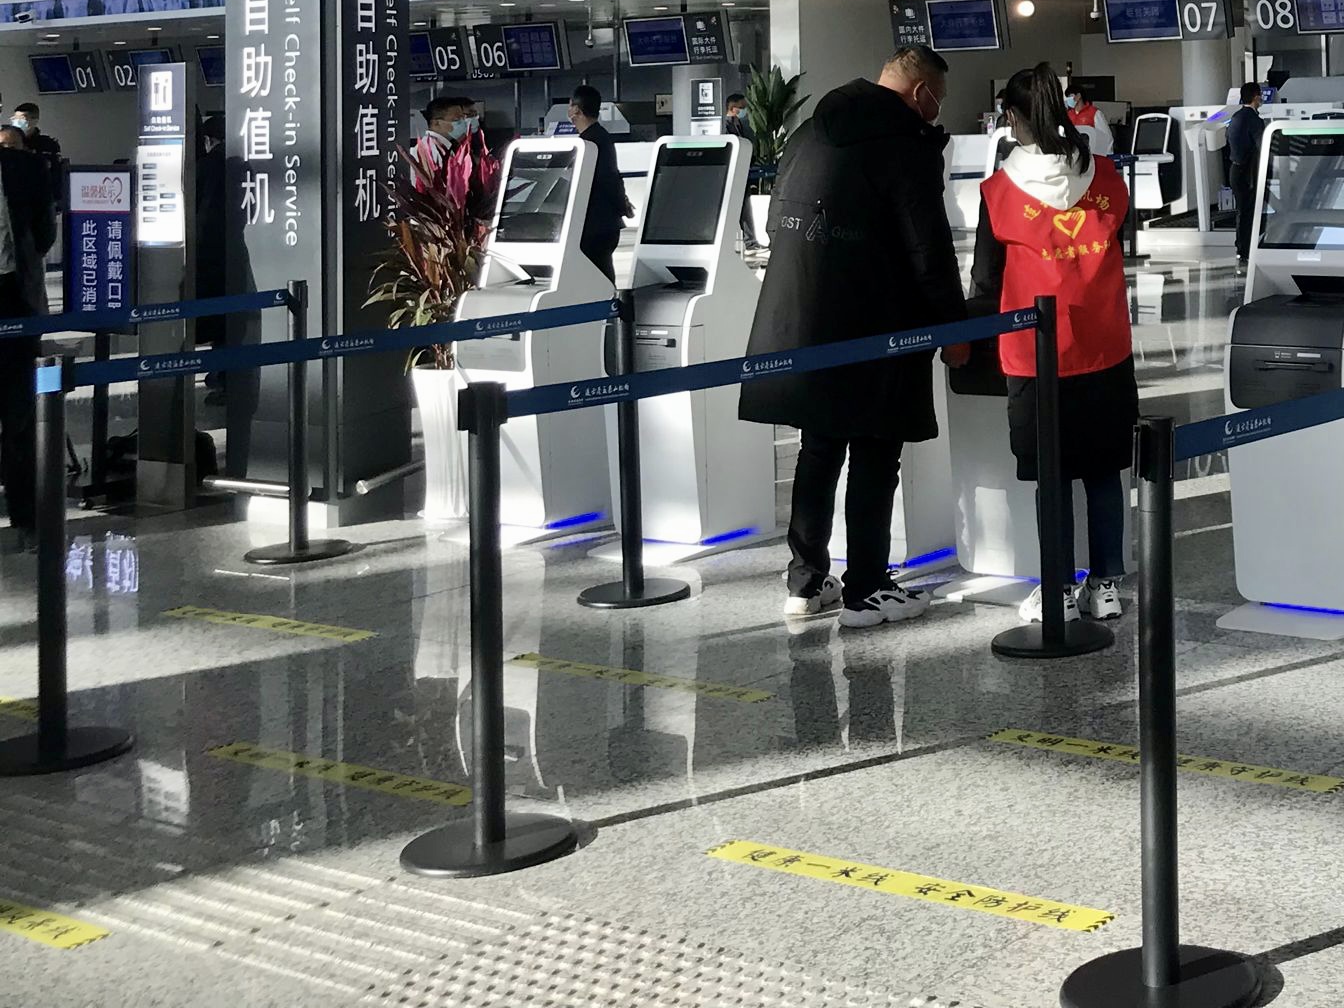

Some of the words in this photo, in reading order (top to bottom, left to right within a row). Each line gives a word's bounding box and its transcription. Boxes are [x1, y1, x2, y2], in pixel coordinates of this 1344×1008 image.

[1183, 2, 1217, 33] 07
[435, 46, 460, 71] 05
[481, 42, 506, 68] 06
[75, 66, 97, 89] 01
[114, 63, 136, 87] 02
[284, 34, 301, 146] Check-in
[385, 35, 399, 142] Check-in
[284, 154, 301, 246] Service
[913, 882, 1077, 924] 安全防护线
